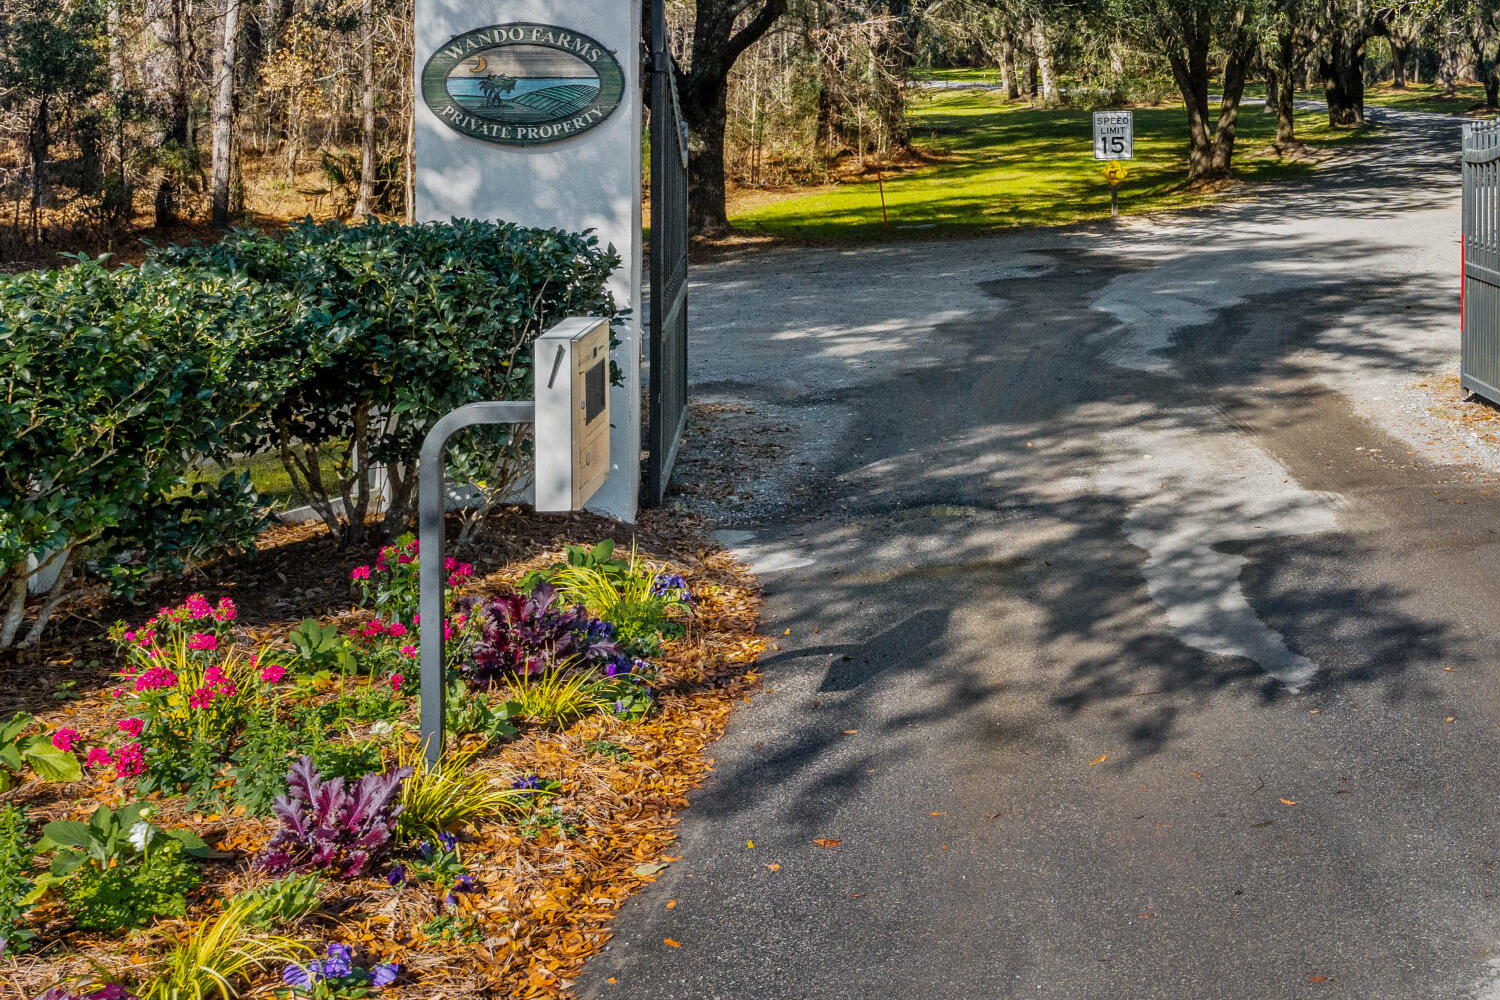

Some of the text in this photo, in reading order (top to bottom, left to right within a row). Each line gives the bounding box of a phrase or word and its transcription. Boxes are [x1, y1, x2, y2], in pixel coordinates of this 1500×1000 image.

[444, 27, 602, 62] WANDO FARMS
[441, 105, 603, 139] PRIVATE PROPERTY
[1097, 117, 1129, 125] SPEED
[1100, 127, 1125, 135] LIMIT
[1101, 136, 1125, 154] 15
